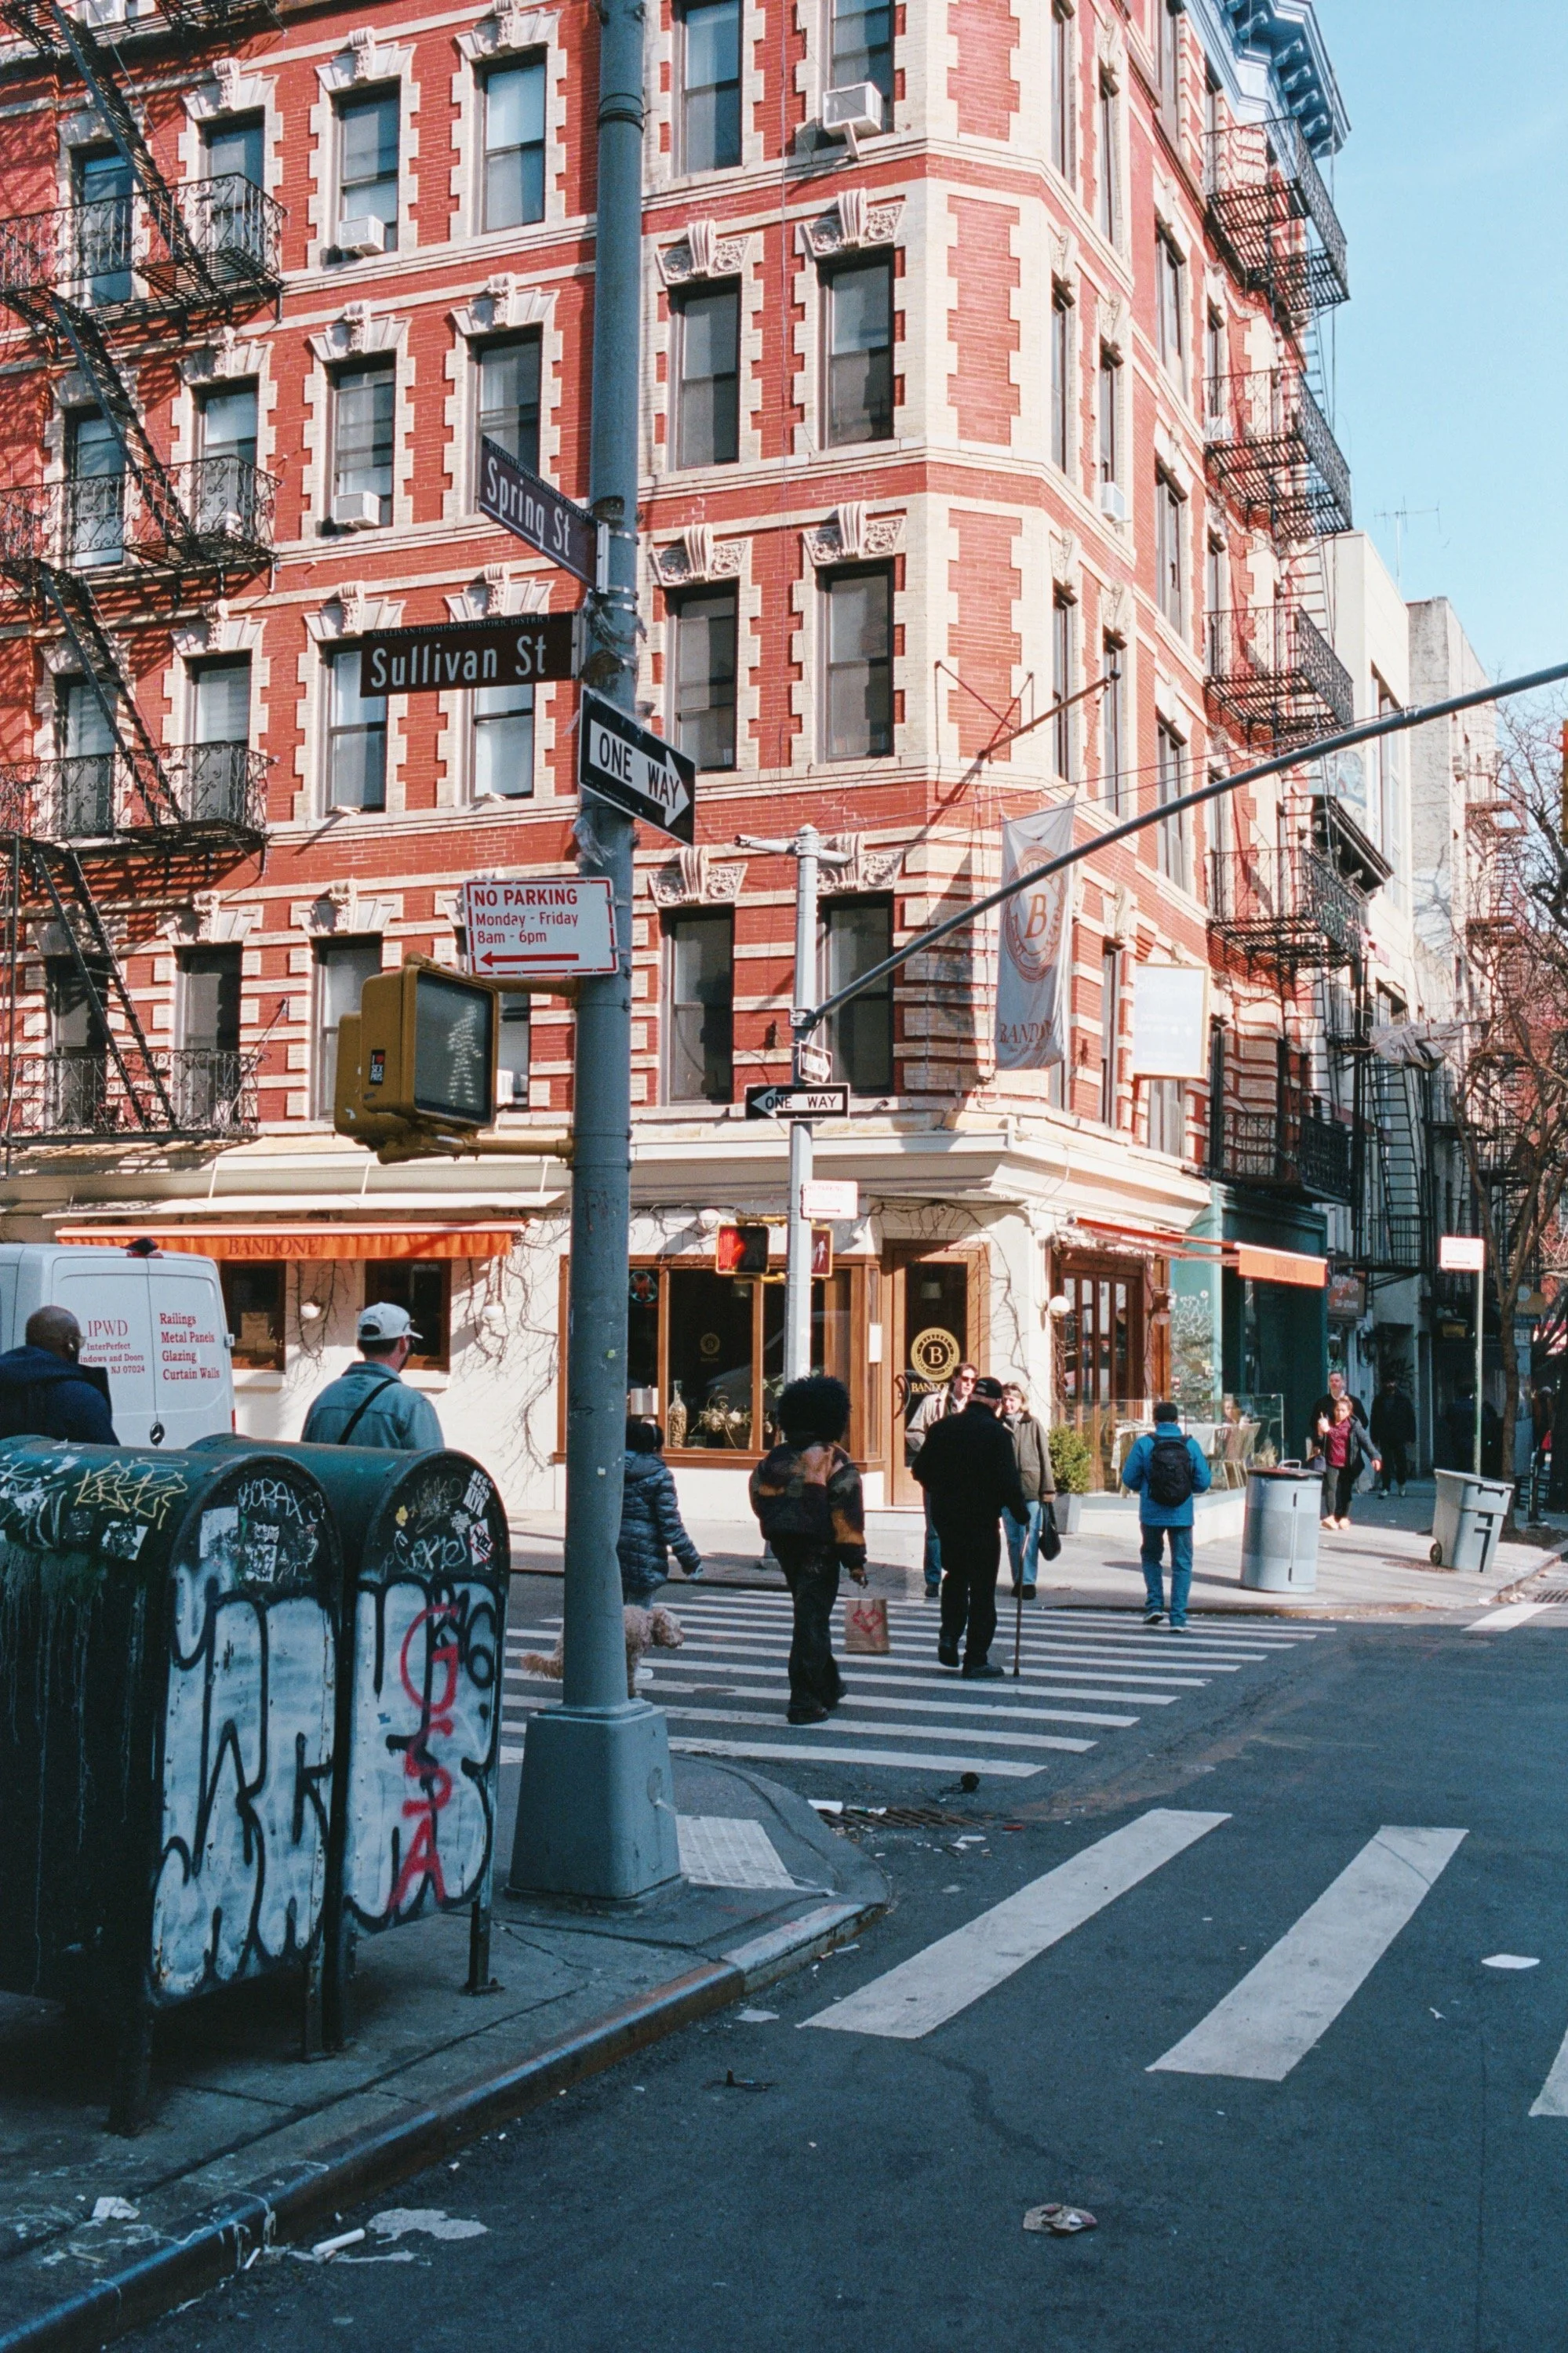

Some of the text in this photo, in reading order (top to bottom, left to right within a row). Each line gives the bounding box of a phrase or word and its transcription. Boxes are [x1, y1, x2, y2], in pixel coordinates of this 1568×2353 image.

[486, 456, 570, 557] Spring St
[372, 615, 550, 638] SULLIVAN-THOMPSON HISTORIC DISTRICT
[370, 634, 547, 689] Sullivan St
[599, 732, 633, 783] ONE
[647, 761, 680, 809] WAY
[474, 888, 578, 907] NO PARKING
[475, 912, 526, 929] Monday
[539, 911, 579, 928] Friday
[1024, 893, 1048, 939] B
[477, 930, 505, 944] 8am
[518, 929, 547, 945] 6pm
[765, 1096, 837, 1110] ONE WAY
[227, 1238, 318, 1255] BANDONE
[87, 1319, 128, 1337] IPWD
[159, 1312, 196, 1327] Railings
[161, 1331, 215, 1344] Metal Panels
[87, 1342, 131, 1351] InterPerfect
[78, 1355, 107, 1363] indows
[162, 1349, 197, 1364] Glazing
[929, 1346, 944, 1365] B
[111, 1365, 145, 1374] NJ 07024
[162, 1367, 220, 1380] Curtain Walls
